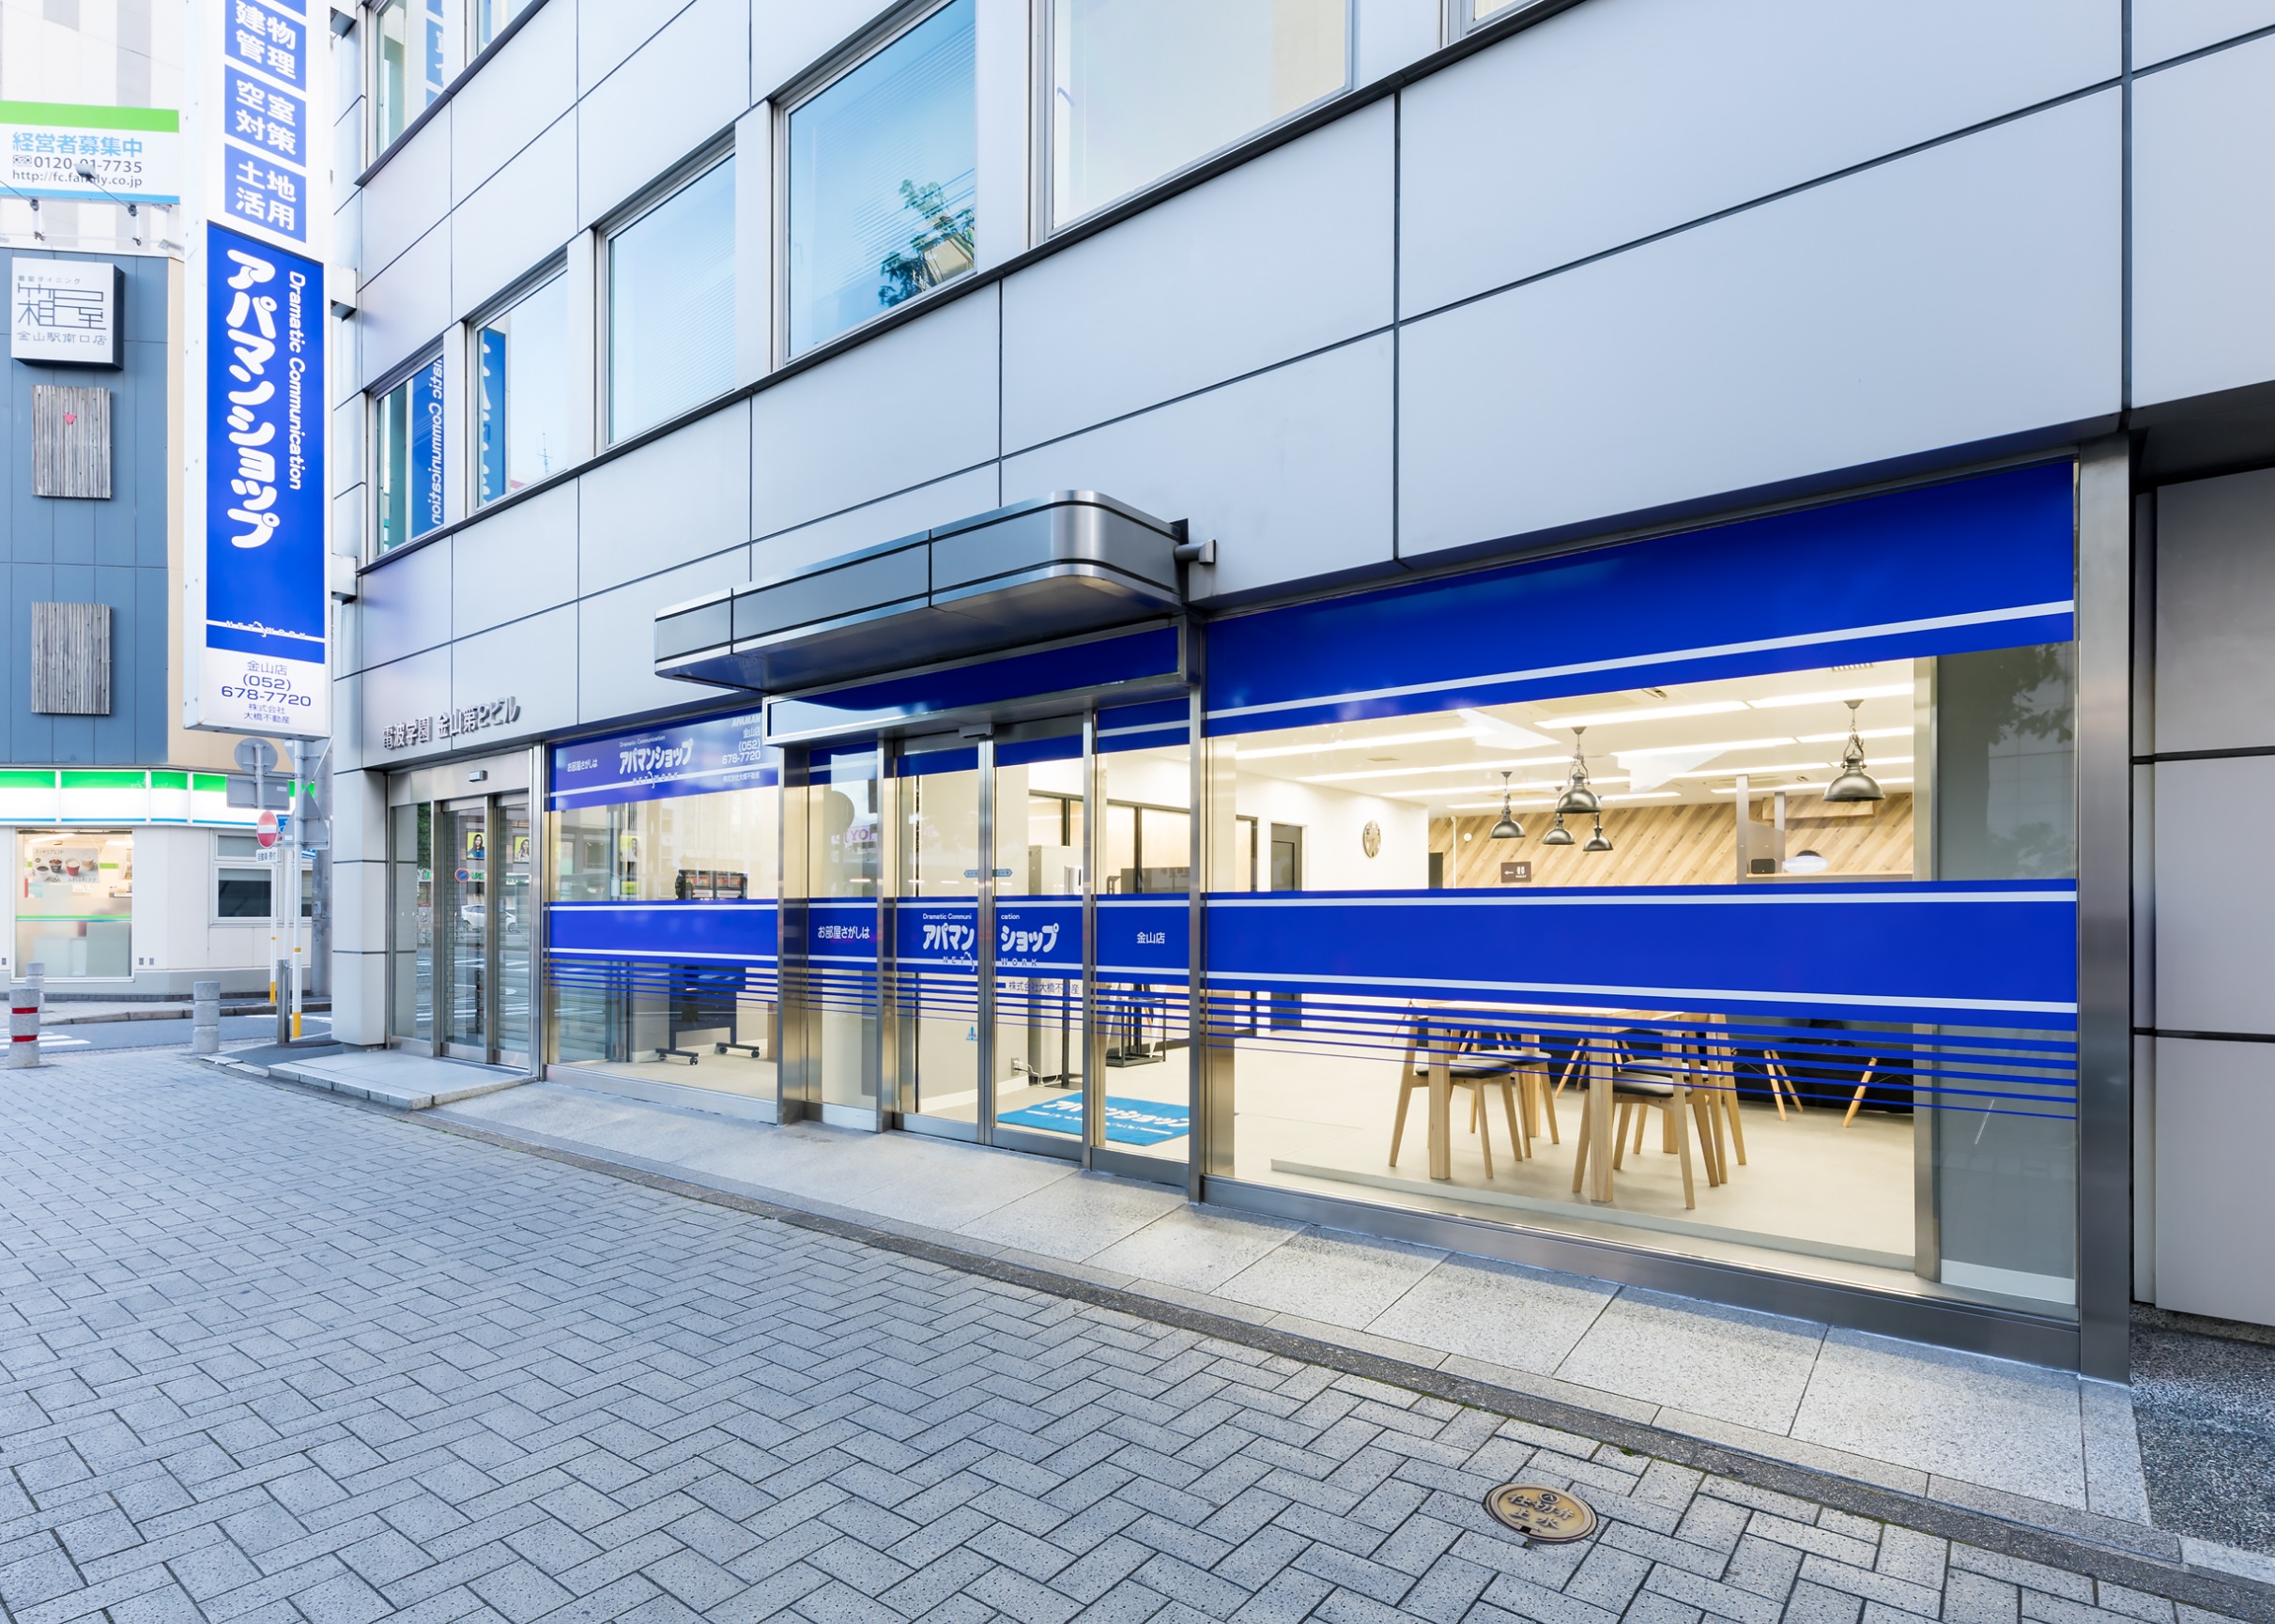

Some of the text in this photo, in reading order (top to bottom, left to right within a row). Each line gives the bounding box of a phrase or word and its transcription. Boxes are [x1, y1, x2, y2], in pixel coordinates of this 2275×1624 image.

[236, 0, 297, 50] 建物
[236, 29, 296, 80] 管理
[236, 80, 296, 127] 空室
[12, 132, 143, 158] 経営者募集中
[236, 110, 297, 156] 対策
[34, 156, 143, 174] 01201-7735
[236, 161, 297, 203] 土地
[236, 188, 295, 231] 活用
[289, 270, 306, 490] Dramatic Communication
[226, 249, 281, 549] アパマンショップ
[243, 674, 291, 692] (052)
[247, 660, 287, 676] 金山店
[222, 686, 311, 707] 678-7720
[619, 738, 694, 775] アパマンショップ
[722, 750, 761, 765] 678-7720
[739, 739, 761, 753] (052)
[818, 926, 870, 940] お部屋さがしは
[923, 922, 1060, 953] アパマン ショップ
[1136, 931, 1165, 944] 金山店
